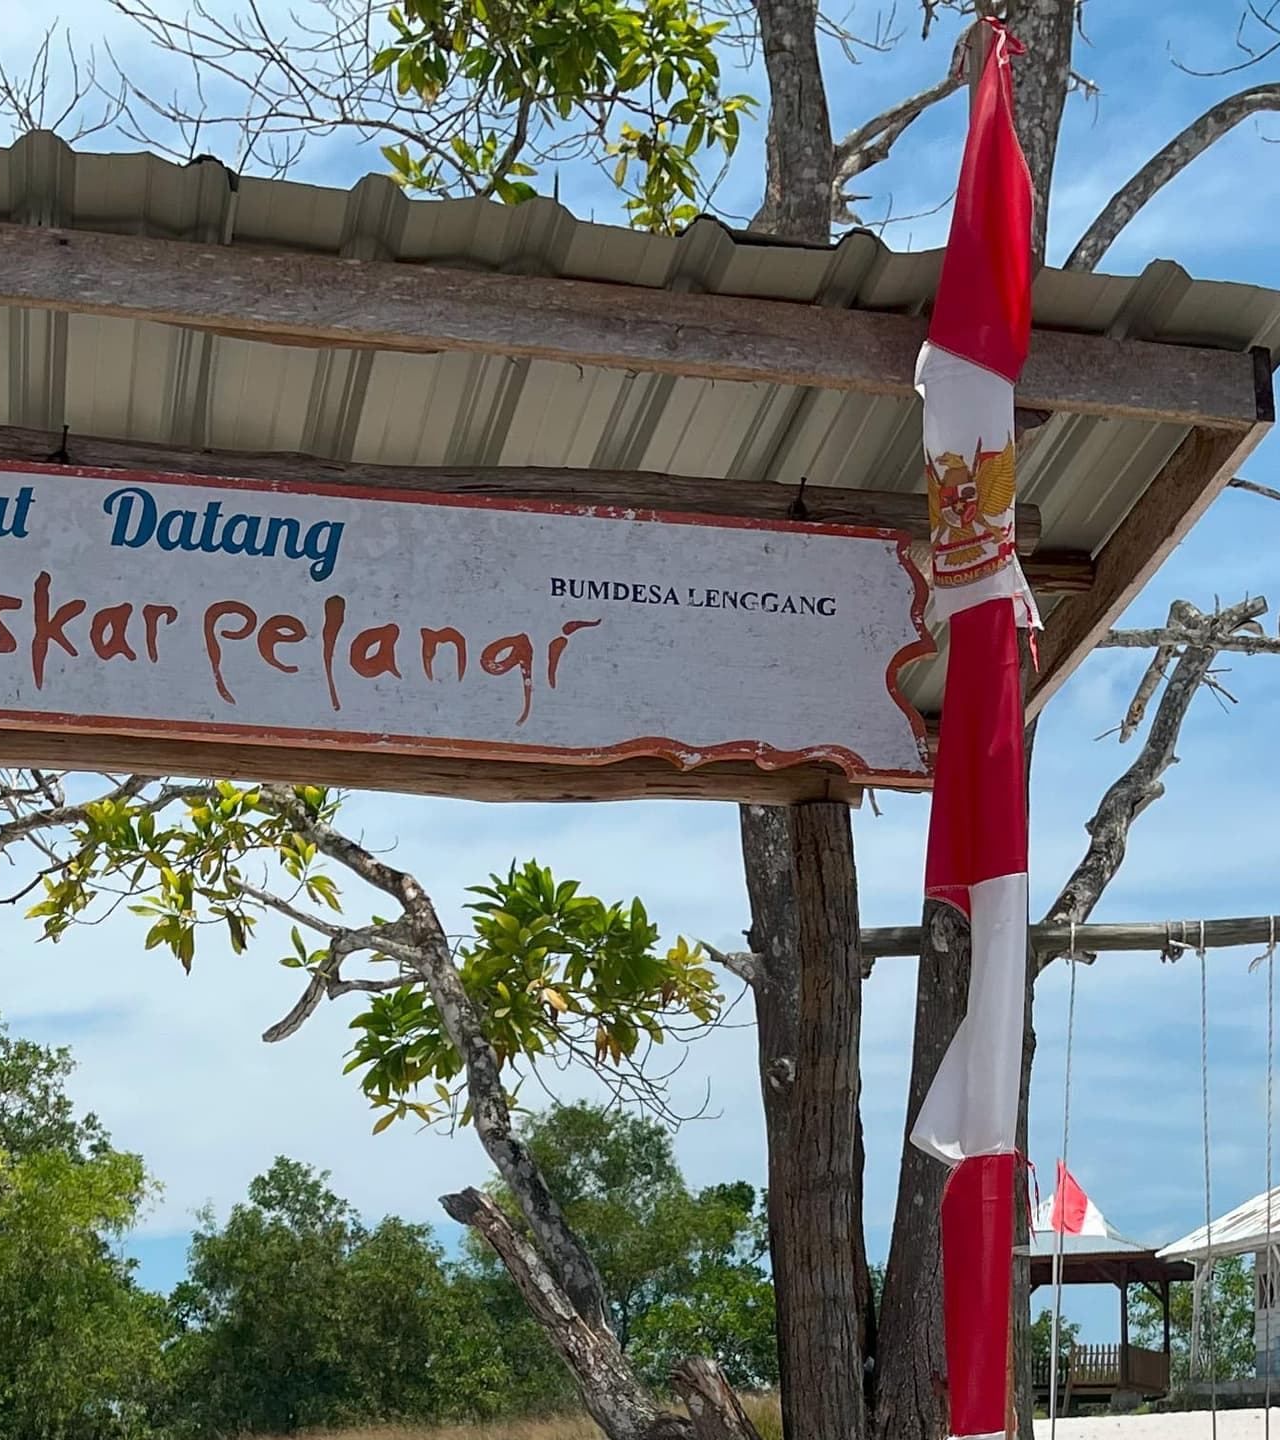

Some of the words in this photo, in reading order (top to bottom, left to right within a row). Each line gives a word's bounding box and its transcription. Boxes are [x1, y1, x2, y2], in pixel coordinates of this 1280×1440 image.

[102, 487, 346, 581] Datang
[549, 576, 681, 606] BUMDESA
[687, 587, 837, 617] LENGGANG
[204, 595, 604, 725] pelangi
